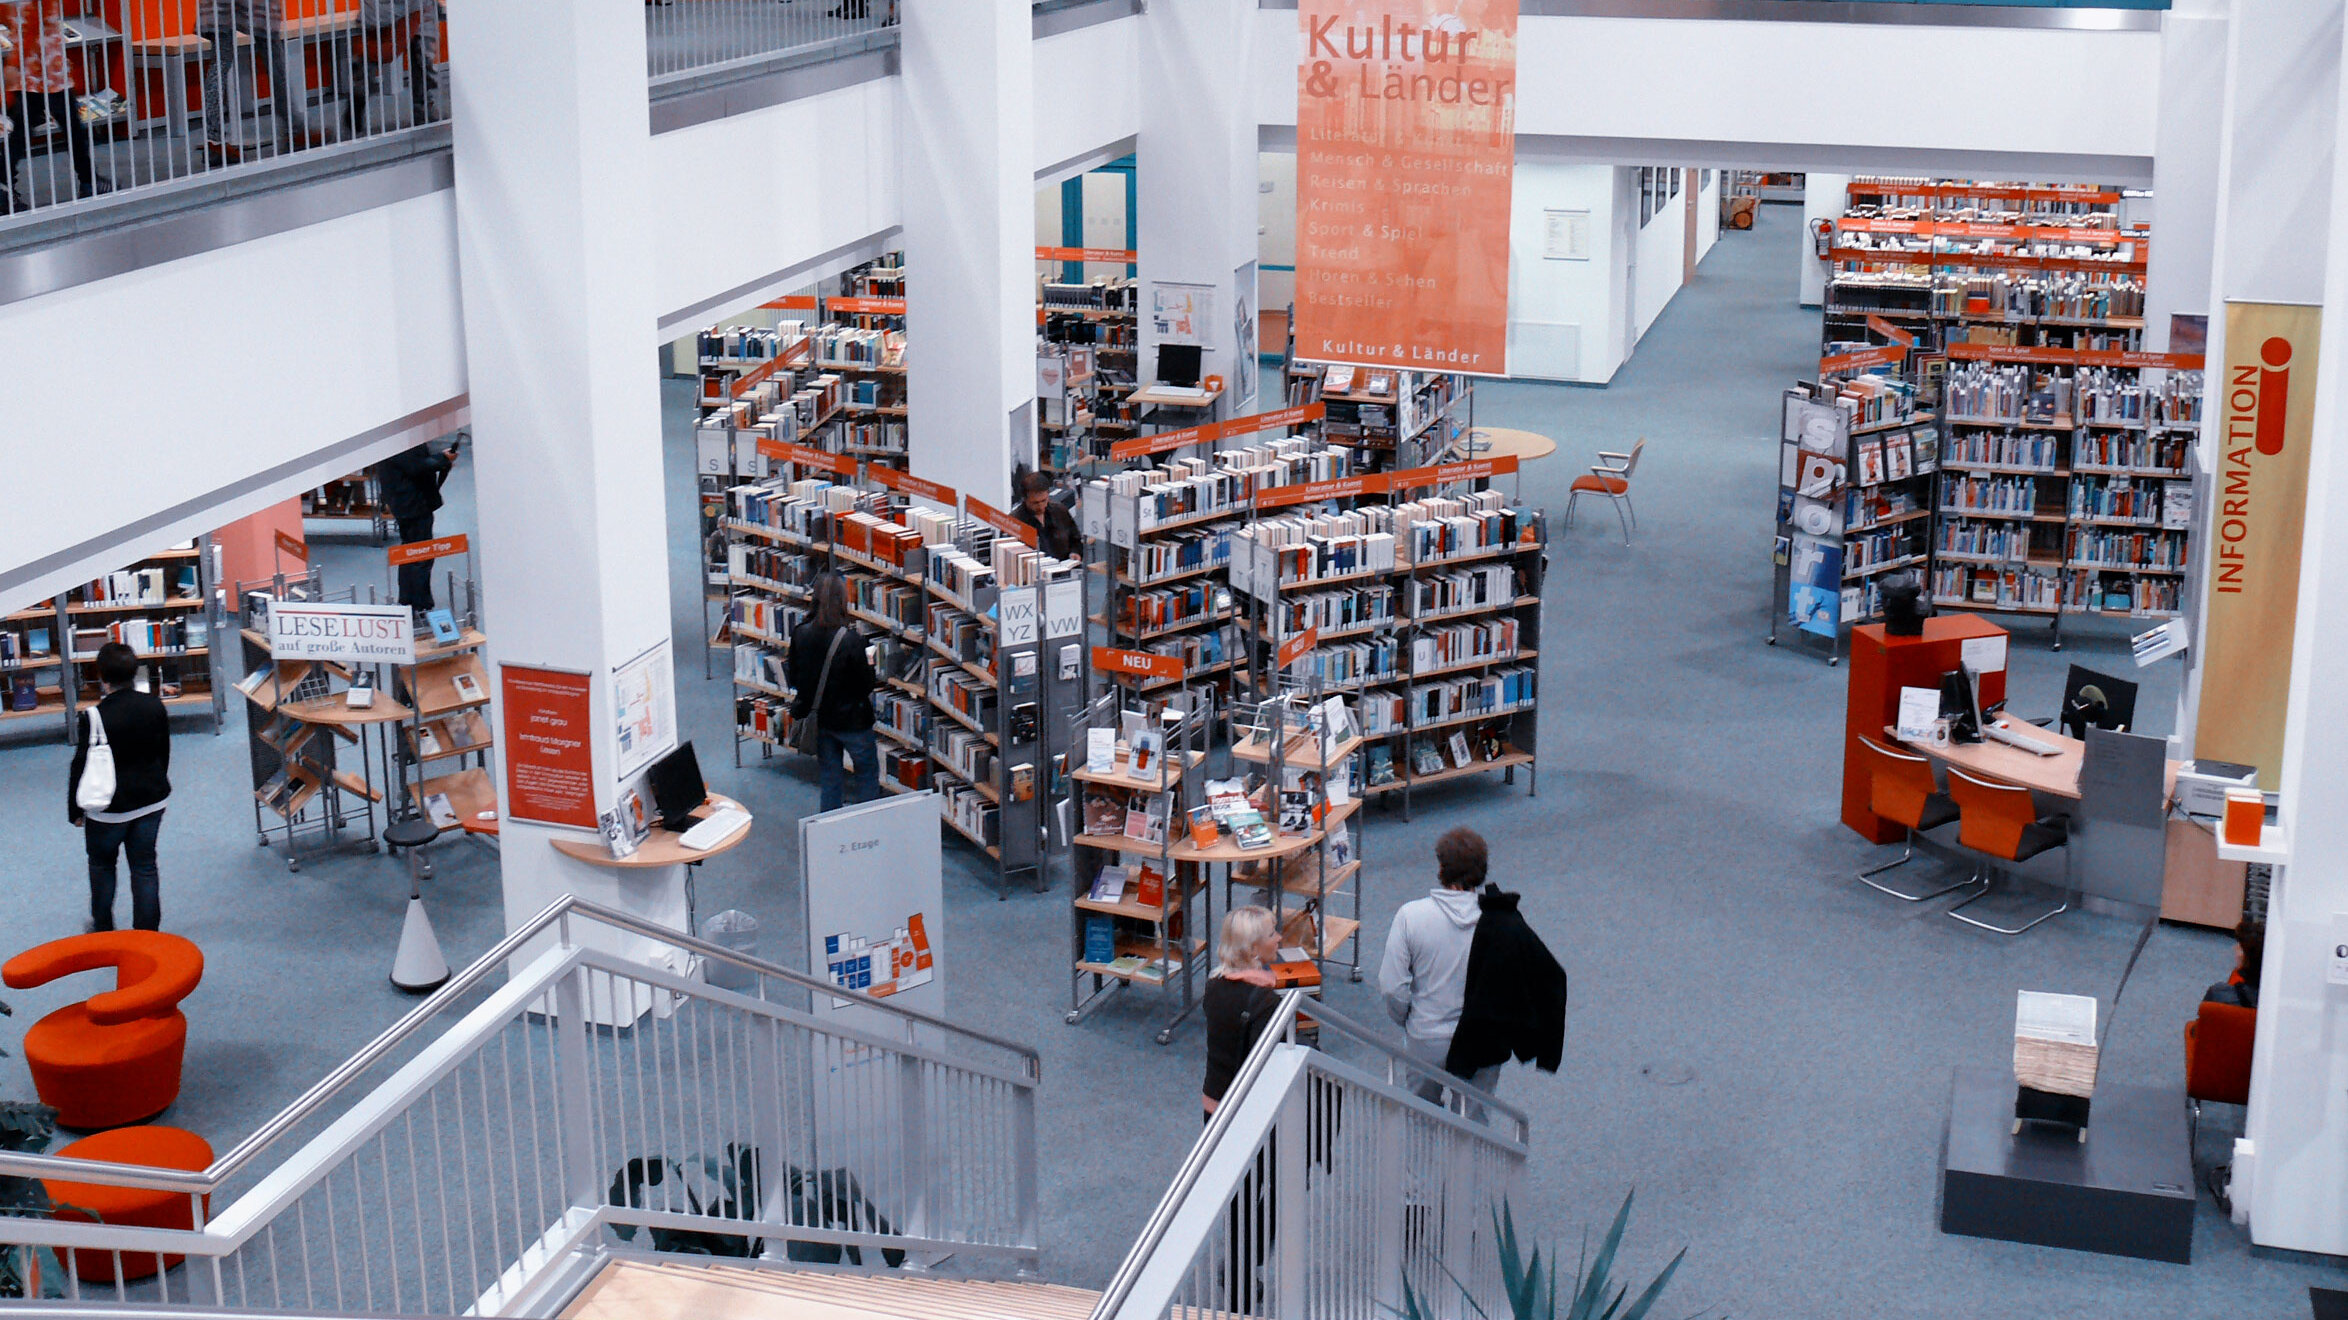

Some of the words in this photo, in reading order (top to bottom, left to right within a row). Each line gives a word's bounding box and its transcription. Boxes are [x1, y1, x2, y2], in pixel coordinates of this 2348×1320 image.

[1308, 14, 1477, 64] Kultur
[1306, 60, 1338, 98] &
[1360, 63, 1511, 106] Länder
[1311, 153, 1374, 166] Mensch
[1382, 154, 1393, 168] &
[1401, 155, 1507, 176] Gesellschaft
[1310, 175, 1367, 190] Reisen
[1375, 178, 1385, 191] &
[1393, 179, 1472, 196] Sprachen
[1310, 198, 1365, 213] Krimis
[1363, 224, 1374, 237] &
[1381, 225, 1422, 242] Spiel
[1309, 245, 1359, 260] Trend
[1308, 292, 1393, 309] Bestseller
[1322, 340, 1386, 356] Kultur
[1393, 344, 1404, 358] &
[1413, 345, 1480, 364] Länder
[709, 458, 719, 471] S
[748, 460, 757, 473] S
[2217, 365, 2259, 593] INFORMATION
[1091, 520, 1099, 534] S
[406, 544, 431, 557] Unser
[432, 541, 452, 555] Tipp
[1004, 602, 1034, 621] WX
[278, 616, 407, 640] LESELUST
[1008, 625, 1031, 641] YZ
[1050, 616, 1079, 634] VW
[278, 640, 302, 652] auf
[307, 640, 346, 655] große
[351, 641, 407, 655] Autoren
[1122, 654, 1152, 670] NEU
[1418, 651, 1426, 661] U
[839, 844, 849, 854] 2.
[851, 838, 880, 851] Etage
